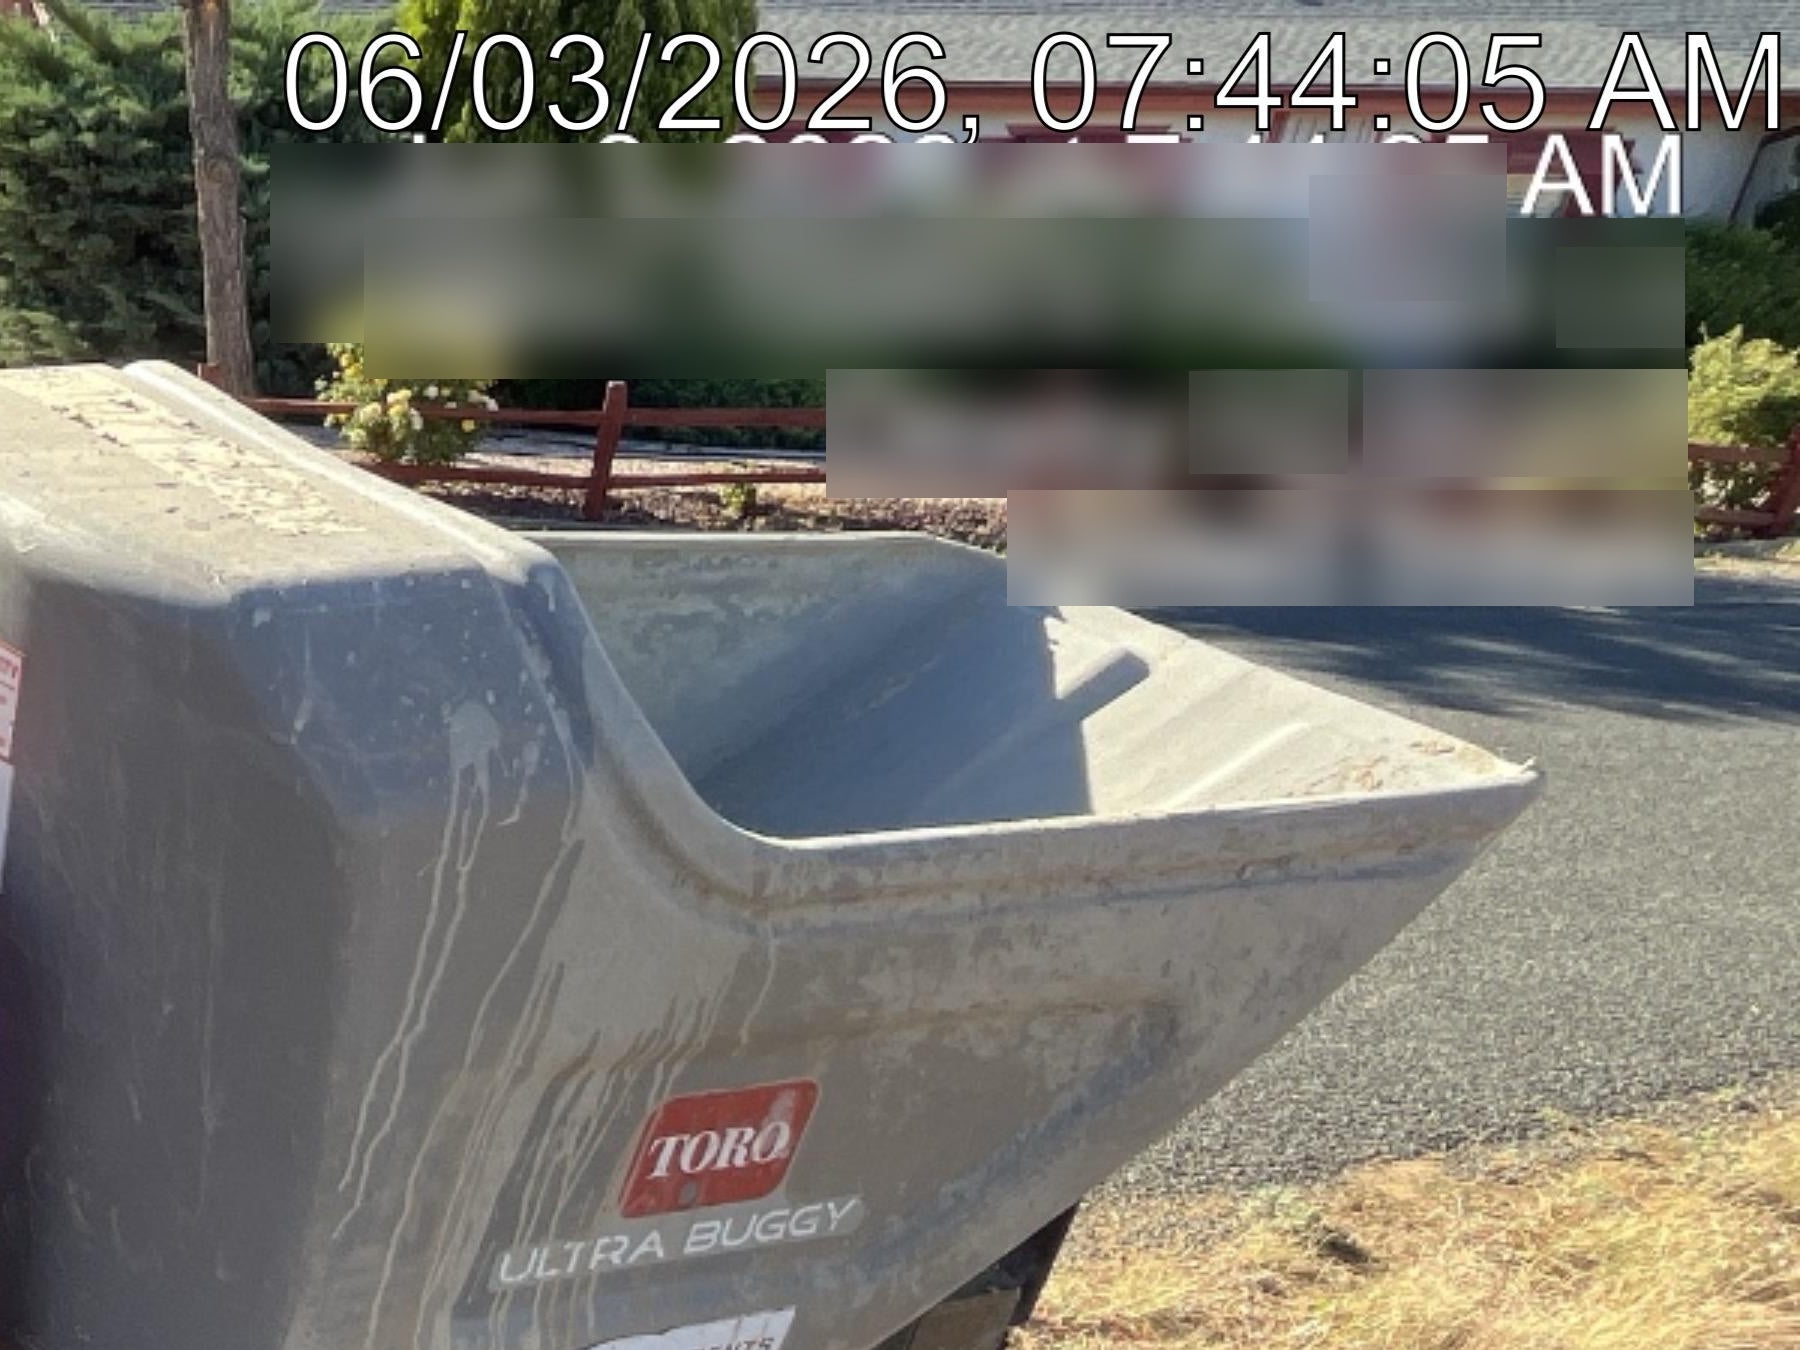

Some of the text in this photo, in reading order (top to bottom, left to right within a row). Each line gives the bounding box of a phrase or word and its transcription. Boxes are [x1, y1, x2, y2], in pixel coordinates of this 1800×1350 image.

[646, 1121, 791, 1180] TORO
[499, 1193, 862, 1283] ULTRA BUGGY
